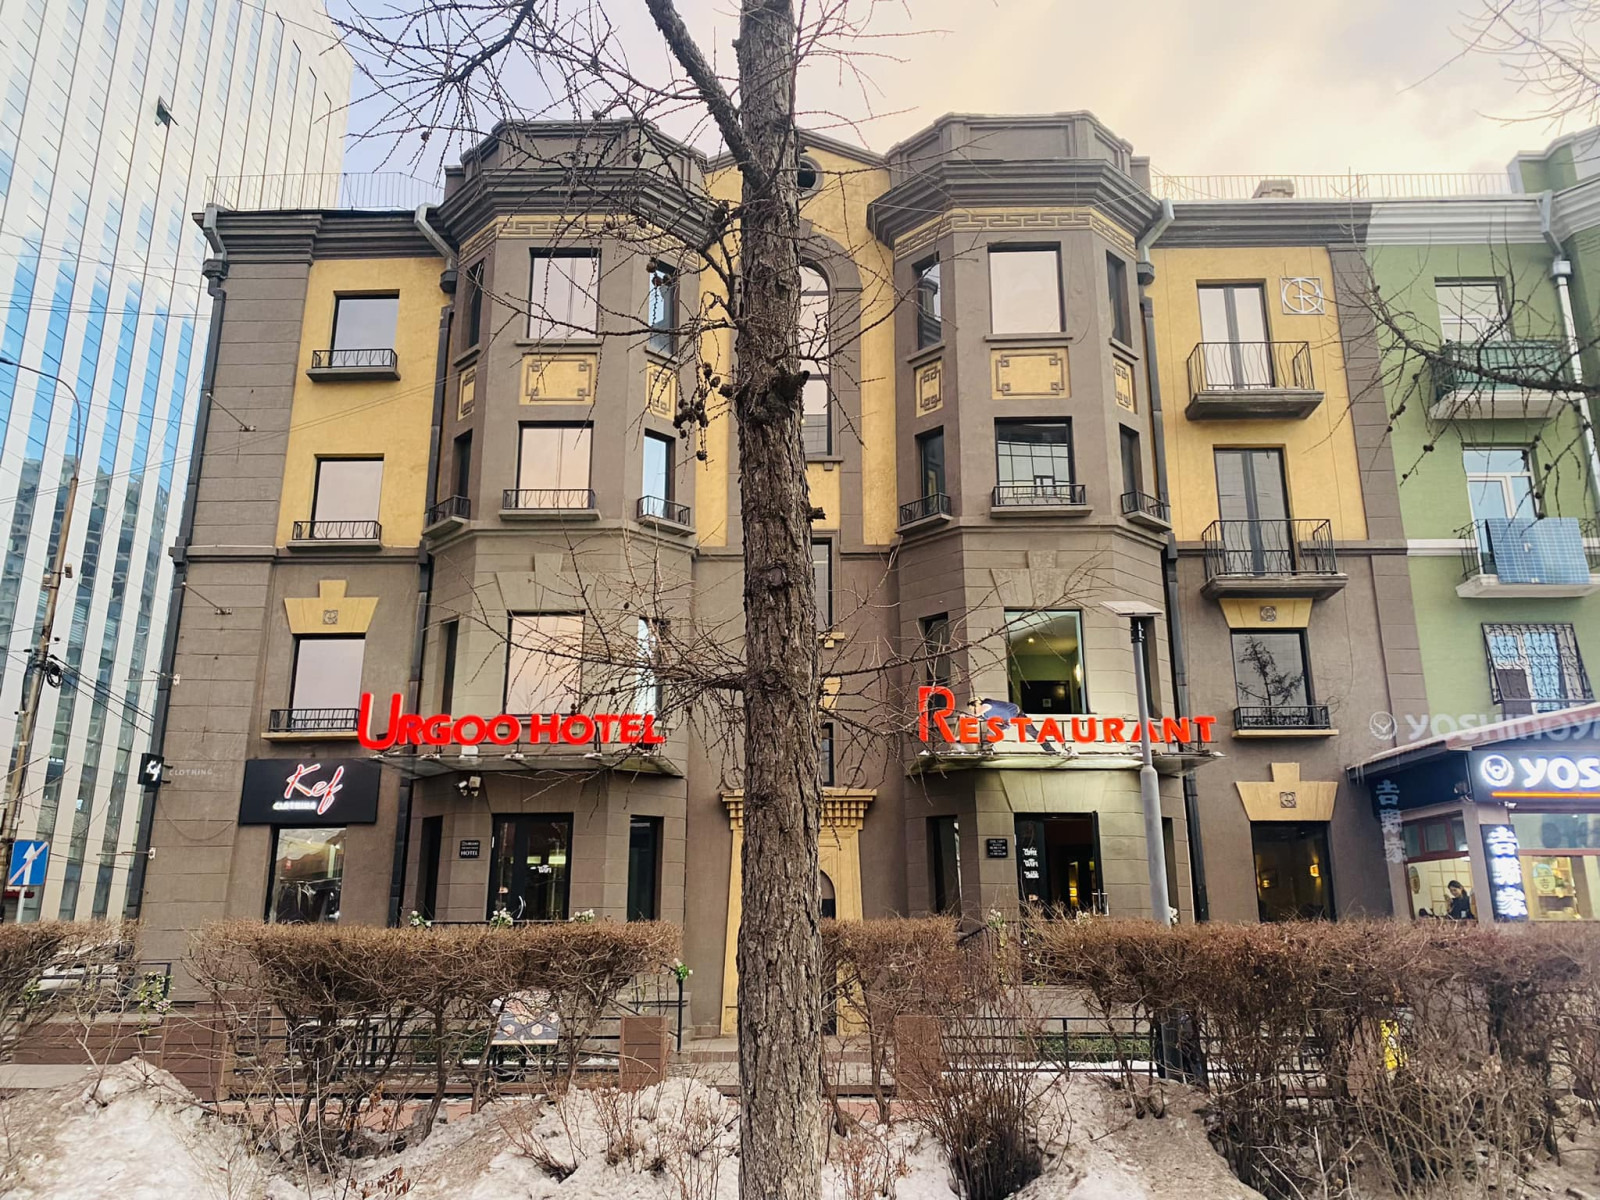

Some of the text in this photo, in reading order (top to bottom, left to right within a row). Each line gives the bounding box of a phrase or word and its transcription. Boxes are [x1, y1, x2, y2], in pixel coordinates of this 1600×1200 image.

[357, 692, 666, 750] URGOO HOTEL
[917, 686, 1217, 743] RESTAURANT
[284, 763, 344, 815] Kef
